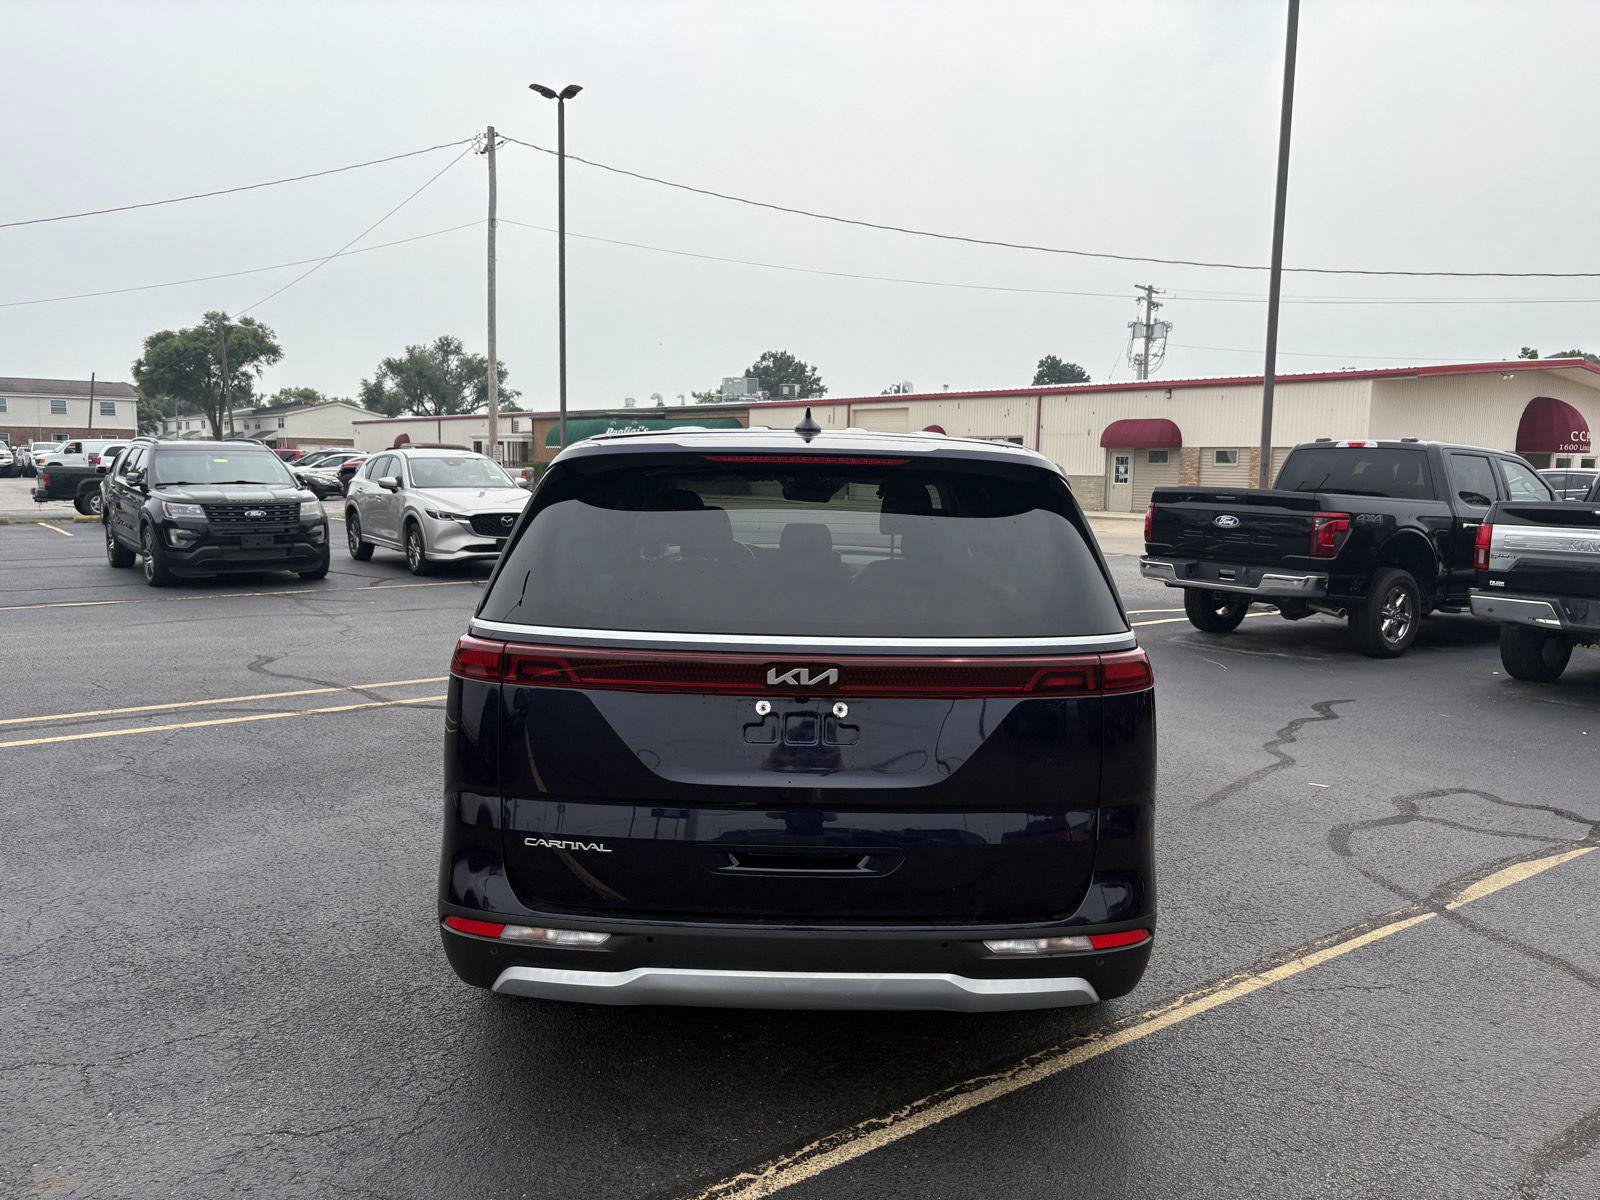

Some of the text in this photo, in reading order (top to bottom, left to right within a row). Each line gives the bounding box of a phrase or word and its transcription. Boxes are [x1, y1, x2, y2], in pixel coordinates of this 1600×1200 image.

[1559, 443, 1579, 451] 1600
[766, 667, 839, 685] KIA
[524, 837, 613, 852] CARNIVAL
